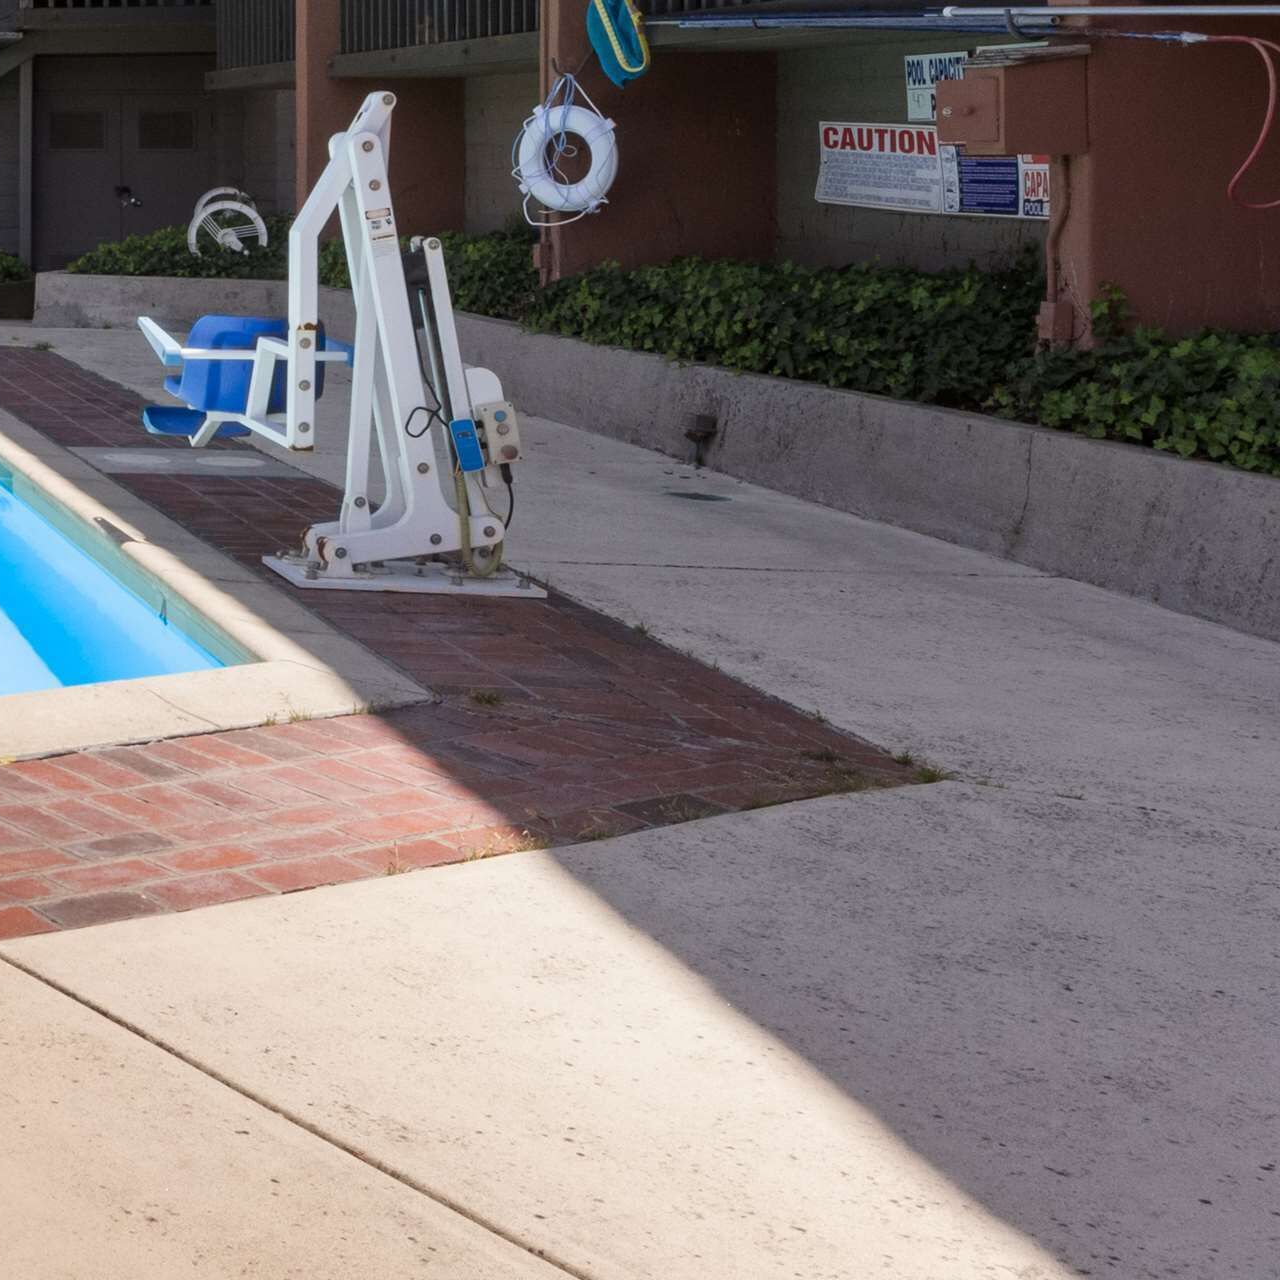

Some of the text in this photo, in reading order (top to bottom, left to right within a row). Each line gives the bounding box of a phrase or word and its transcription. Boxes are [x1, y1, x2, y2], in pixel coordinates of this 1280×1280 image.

[906, 59, 926, 86] POOL
[822, 126, 937, 156] CAUTION
[1024, 201, 1043, 215] POOL
